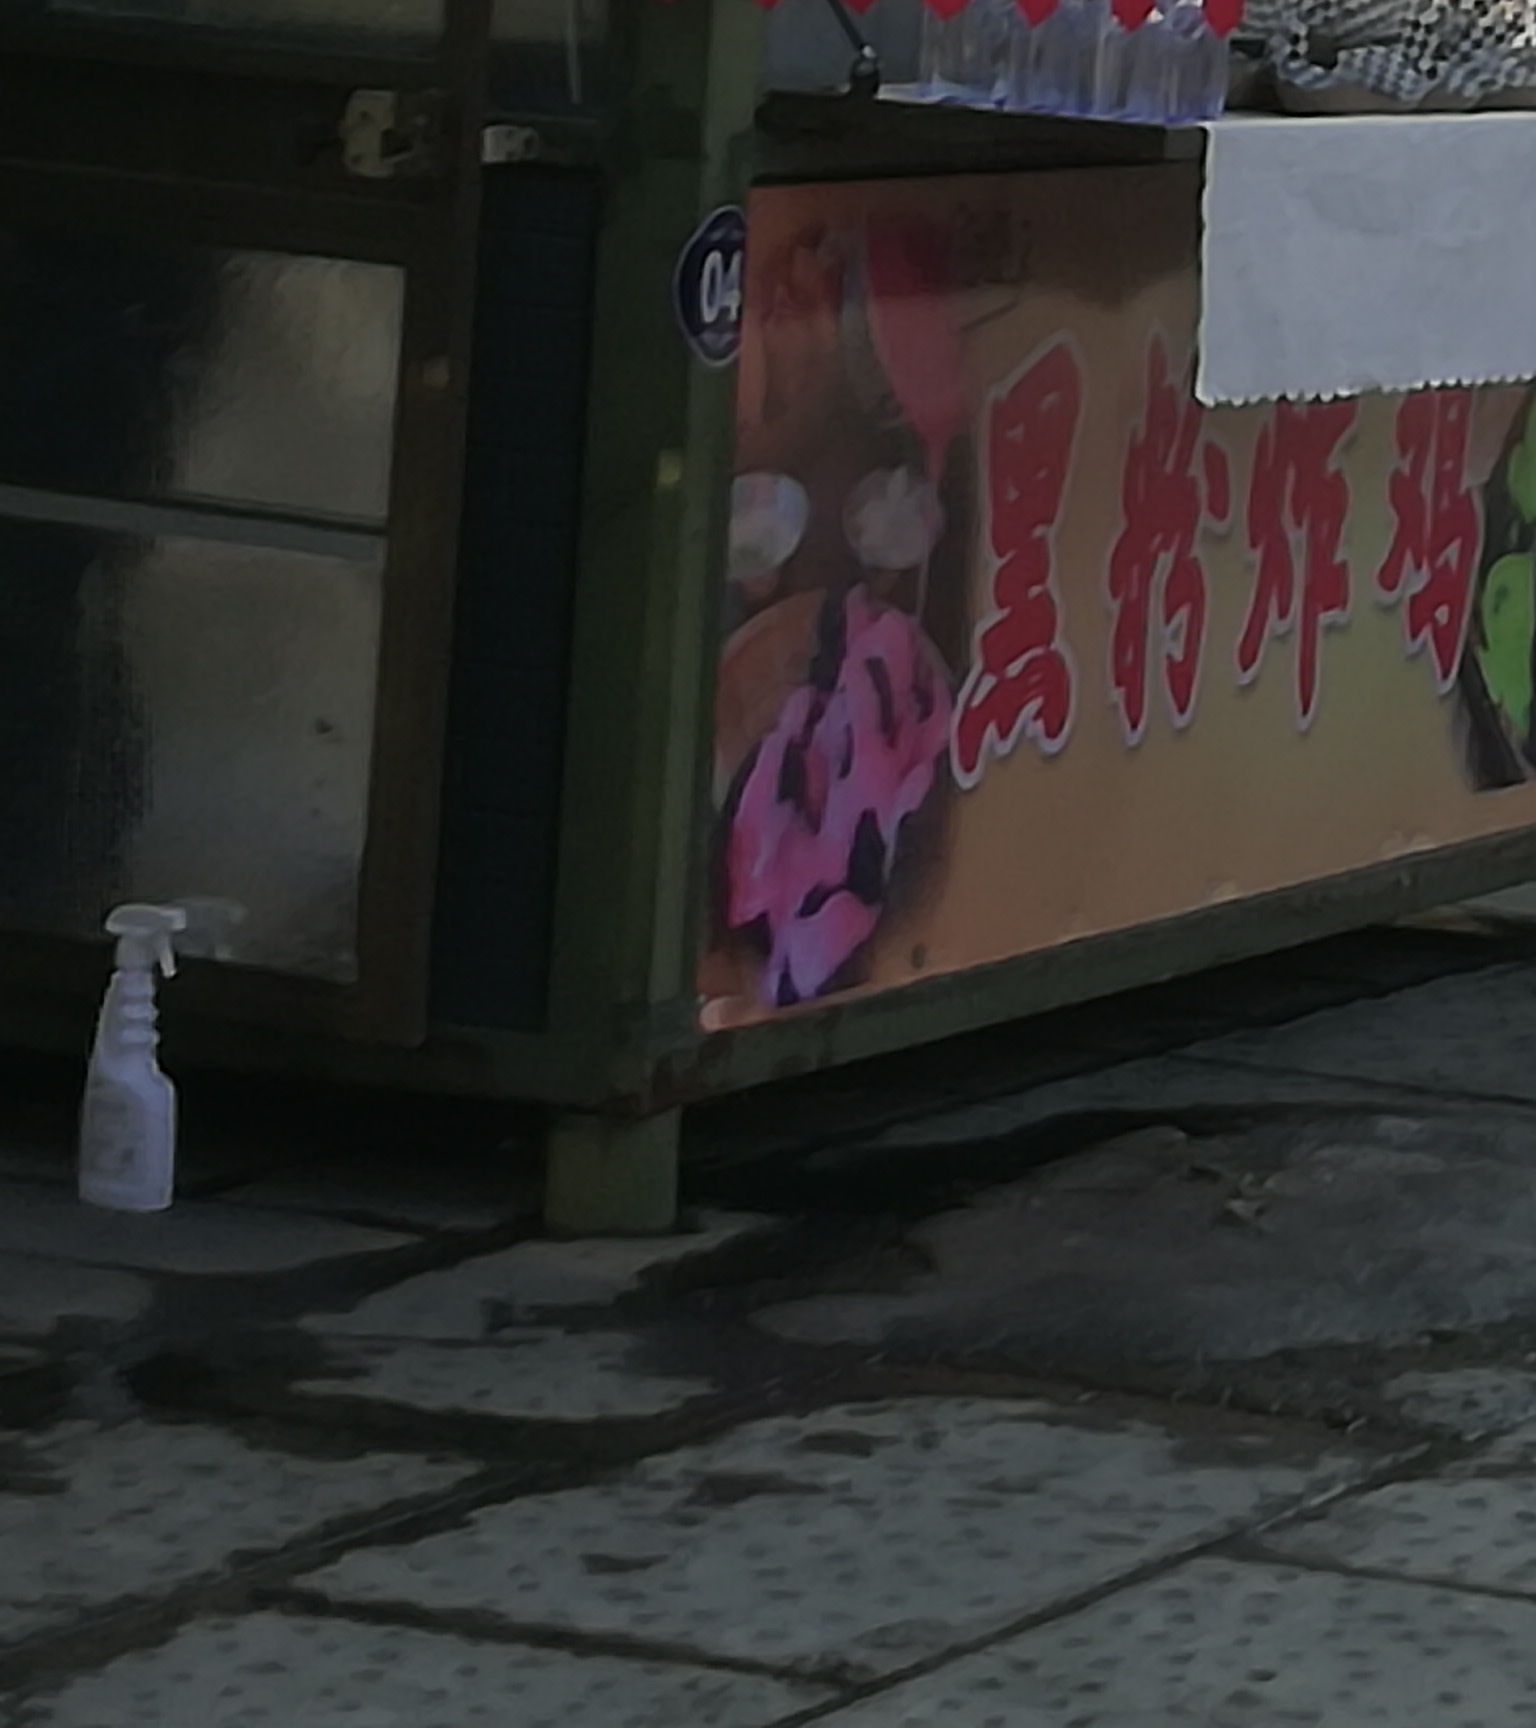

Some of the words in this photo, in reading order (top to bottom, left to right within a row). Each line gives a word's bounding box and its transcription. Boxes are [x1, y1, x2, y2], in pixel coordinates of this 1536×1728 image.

[701, 248, 743, 323] 04
[953, 328, 1482, 784] 黑粉炸鸡
